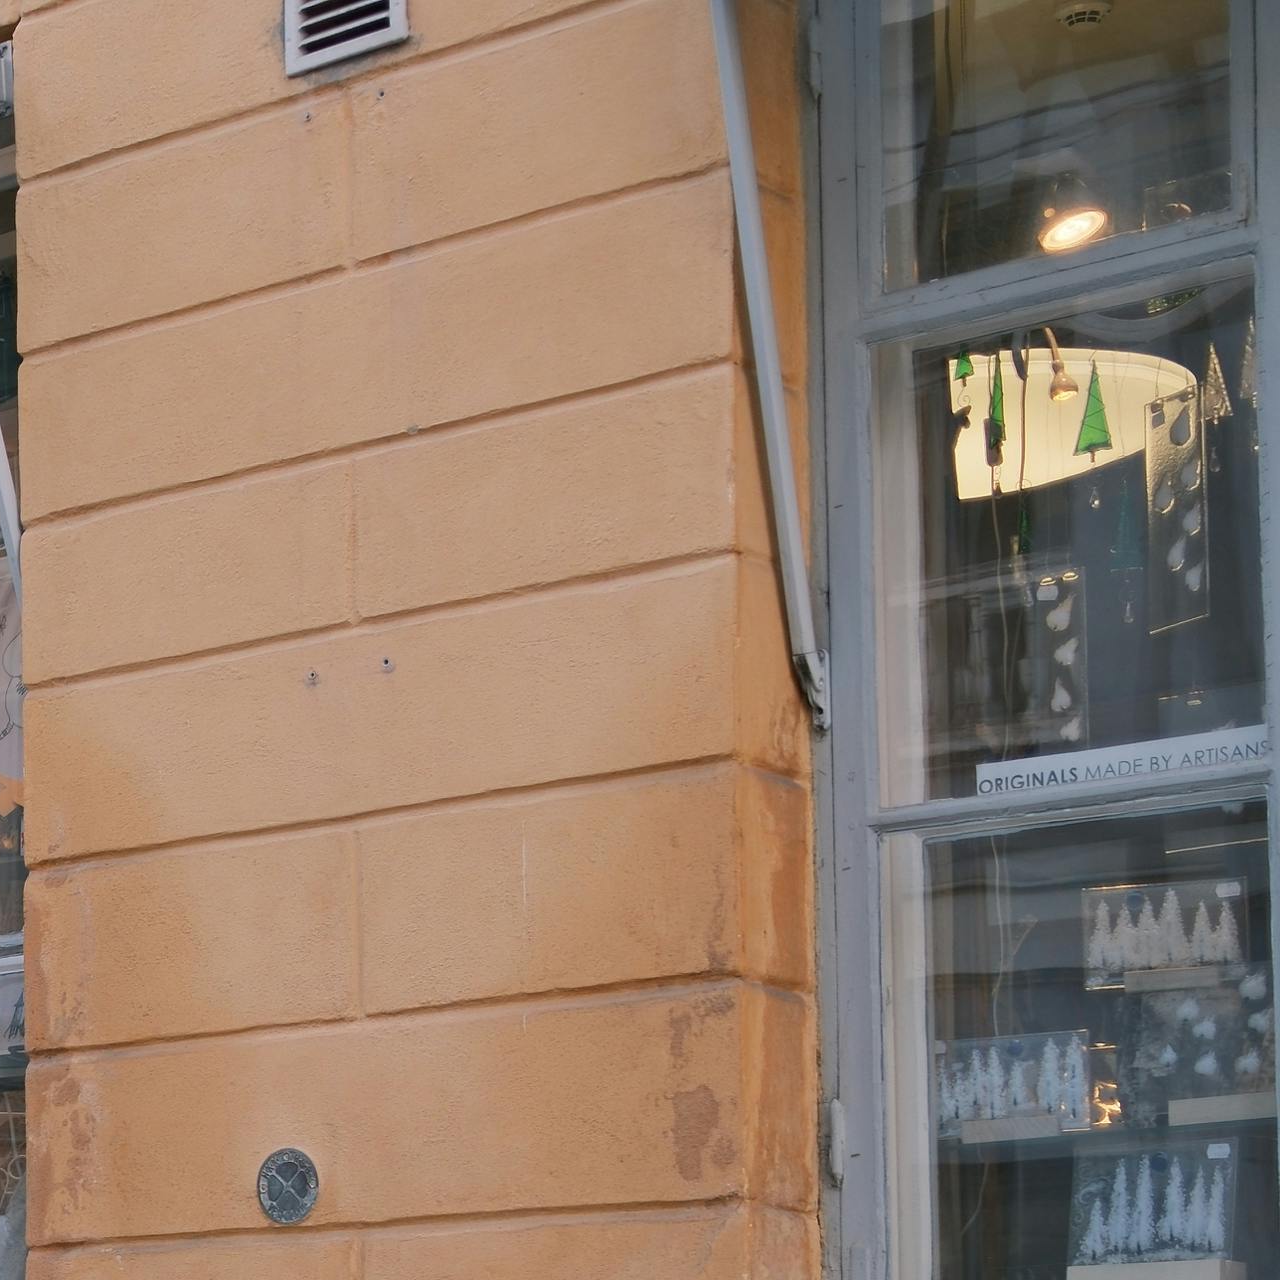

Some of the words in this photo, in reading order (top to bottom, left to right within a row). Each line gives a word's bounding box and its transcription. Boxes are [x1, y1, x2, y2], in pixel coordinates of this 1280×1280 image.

[978, 767, 1078, 794] ORIGINALS
[1085, 758, 1143, 781] MADE
[1150, 753, 1172, 772] BY
